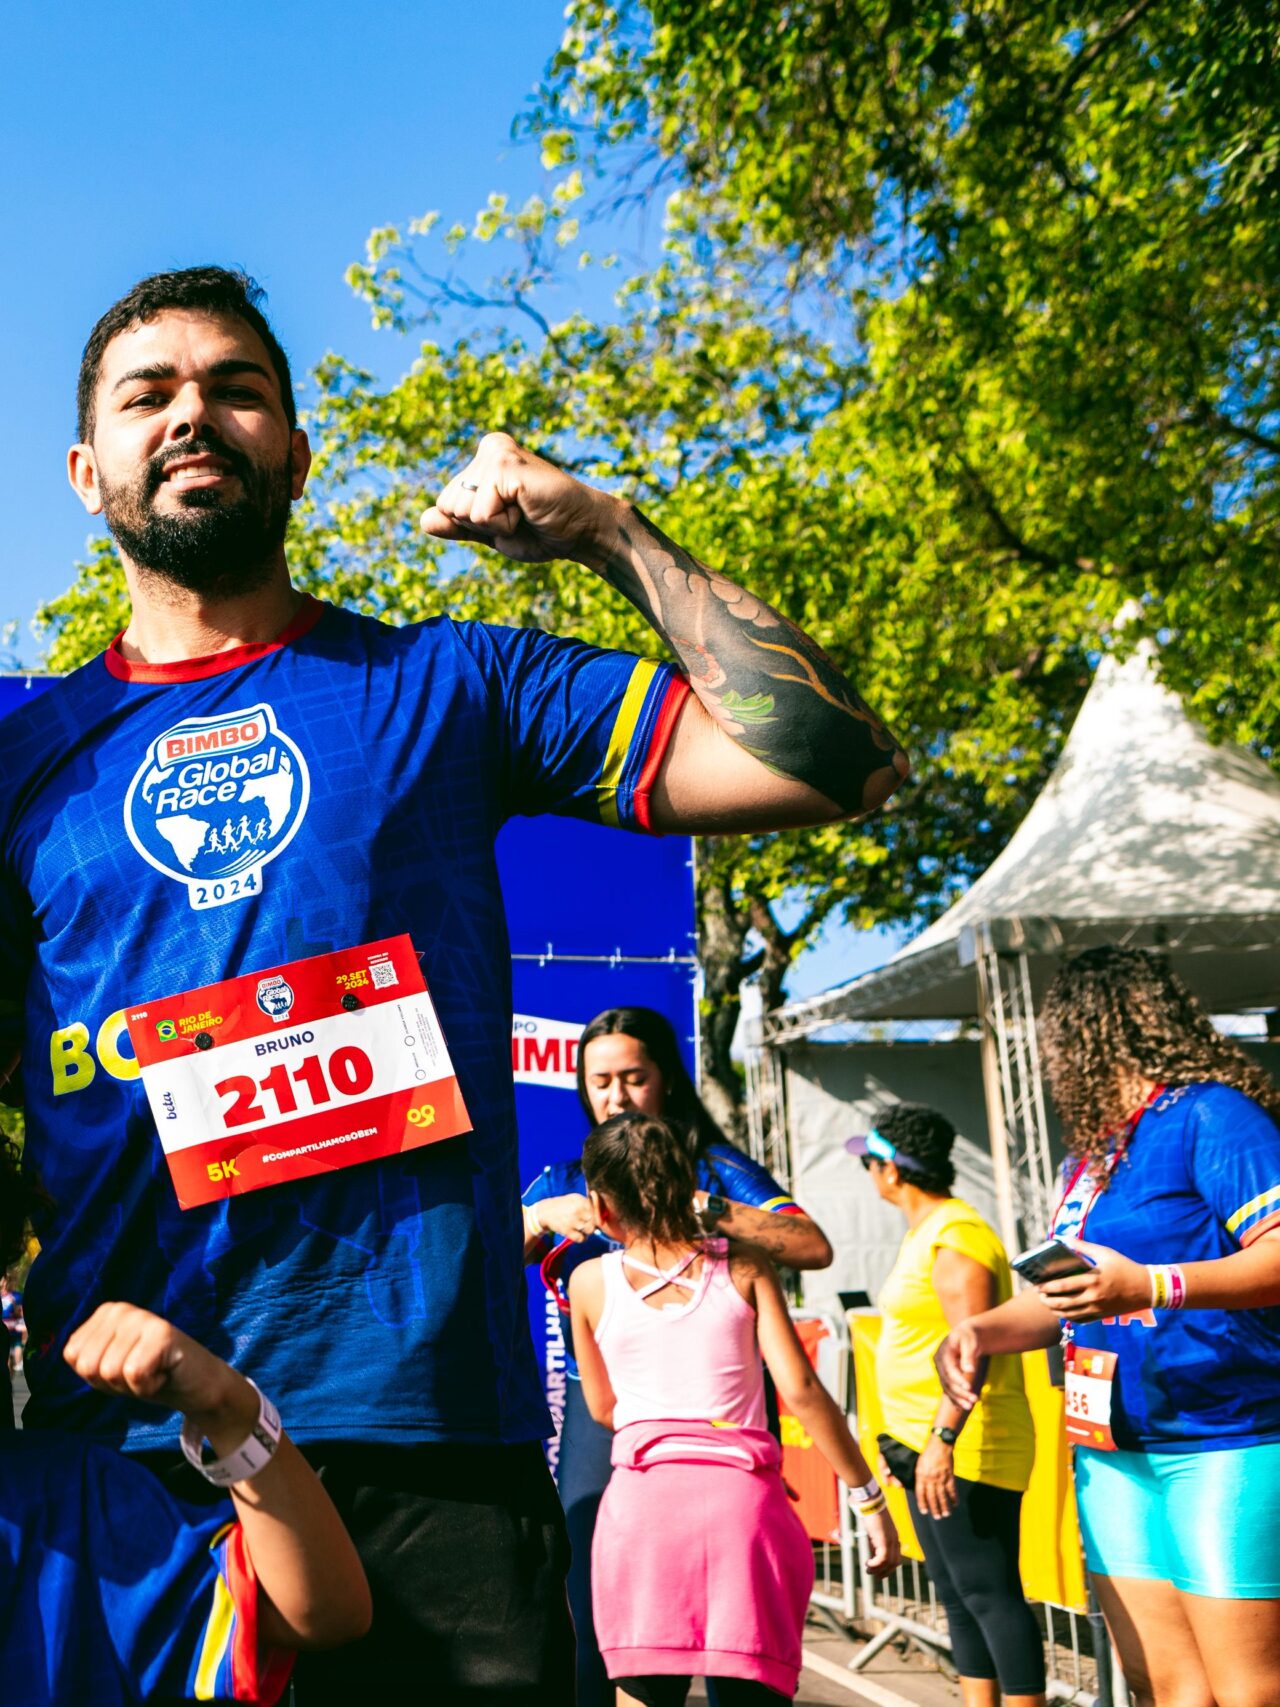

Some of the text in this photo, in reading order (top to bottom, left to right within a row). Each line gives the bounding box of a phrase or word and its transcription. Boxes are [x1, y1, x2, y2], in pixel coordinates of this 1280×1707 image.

[166, 722, 259, 759] BIMBO
[177, 746, 277, 789] Global
[155, 780, 238, 815] Race
[196, 873, 257, 905] 2024
[336, 969, 367, 985] 29.SET
[344, 978, 370, 991] 2024
[178, 1010, 212, 1028] RIO DE
[180, 1016, 224, 1035] JANEIRO
[254, 1030, 316, 1057] BRUNO
[214, 1045, 375, 1129] 2110
[162, 1091, 178, 1120] beta
[206, 1158, 241, 1183] 5K
